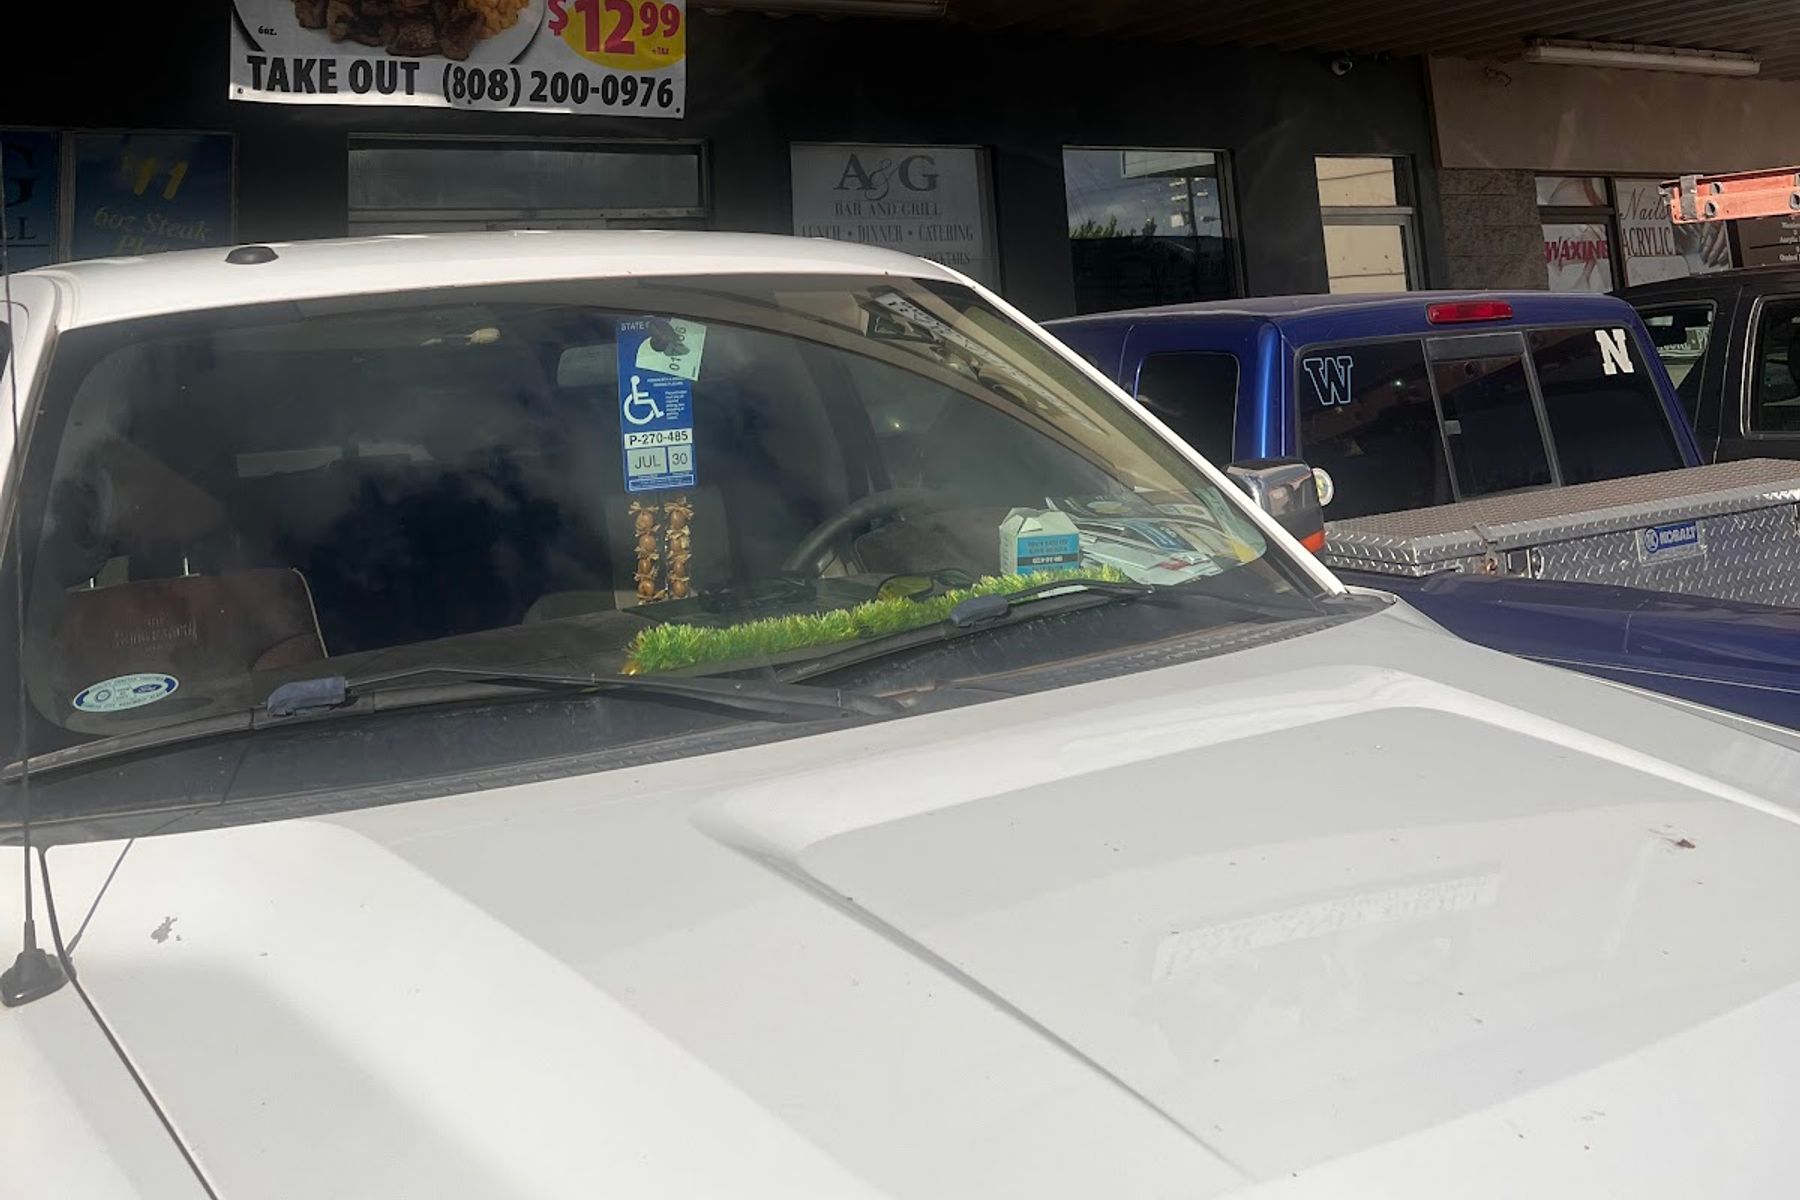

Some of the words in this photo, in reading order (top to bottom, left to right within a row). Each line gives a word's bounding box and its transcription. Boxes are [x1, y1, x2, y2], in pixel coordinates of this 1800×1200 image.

[246, 55, 338, 95] TAKE
[347, 58, 421, 96] OUT
[441, 62, 522, 107] (808)
[529, 70, 675, 109] 200-0976
[833, 152, 940, 201] A&G
[834, 201, 863, 217] BAR
[869, 201, 898, 217] AND
[901, 201, 942, 217] GRILL
[857, 224, 904, 242] DINNER
[918, 224, 974, 242] CATERING
[1594, 328, 1635, 375] N
[1303, 355, 1353, 406] W
[629, 430, 689, 446] P-270-485
[634, 454, 662, 470] JUL
[671, 453, 689, 466] 30
